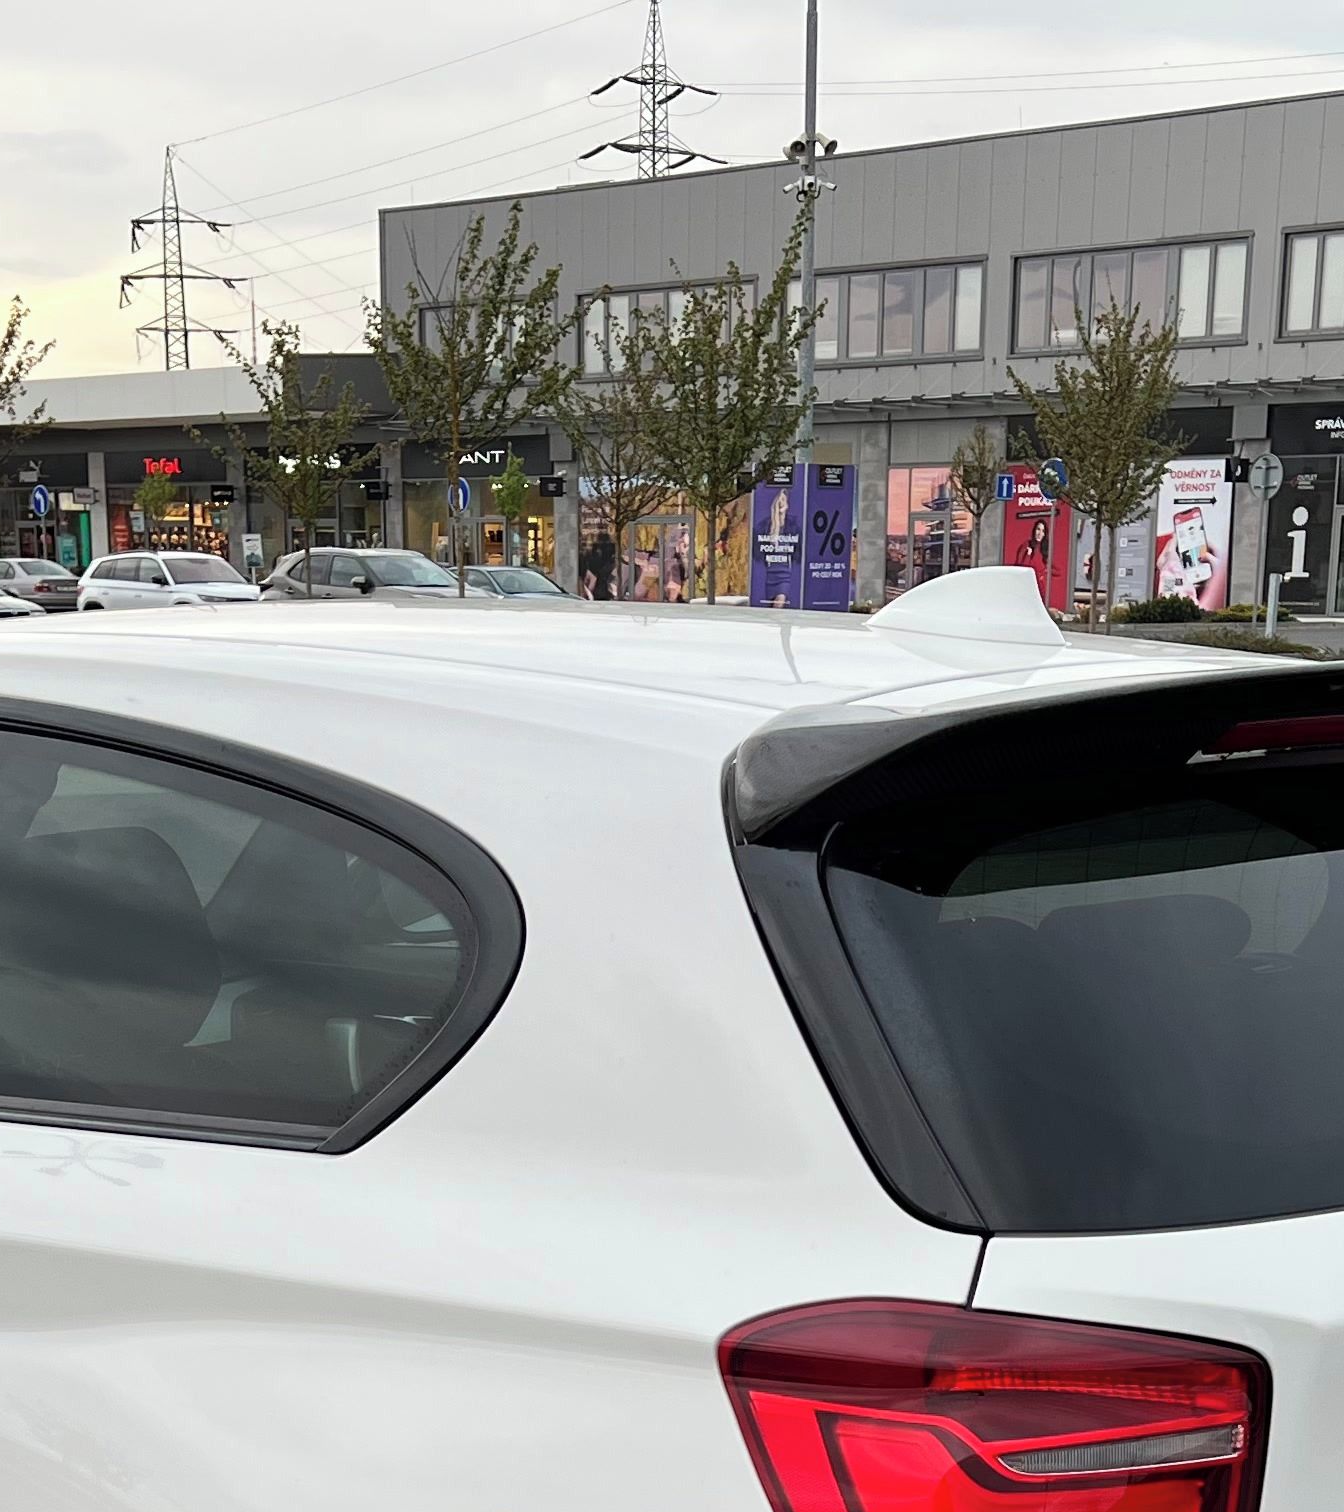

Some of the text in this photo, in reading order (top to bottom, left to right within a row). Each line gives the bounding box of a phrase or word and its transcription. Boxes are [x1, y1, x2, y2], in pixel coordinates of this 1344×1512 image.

[458, 450, 505, 464] ANT
[143, 457, 183, 475] Tefal
[1170, 467, 1222, 479] ODMĚNY ZA
[1174, 481, 1216, 492] VĚRNOST
